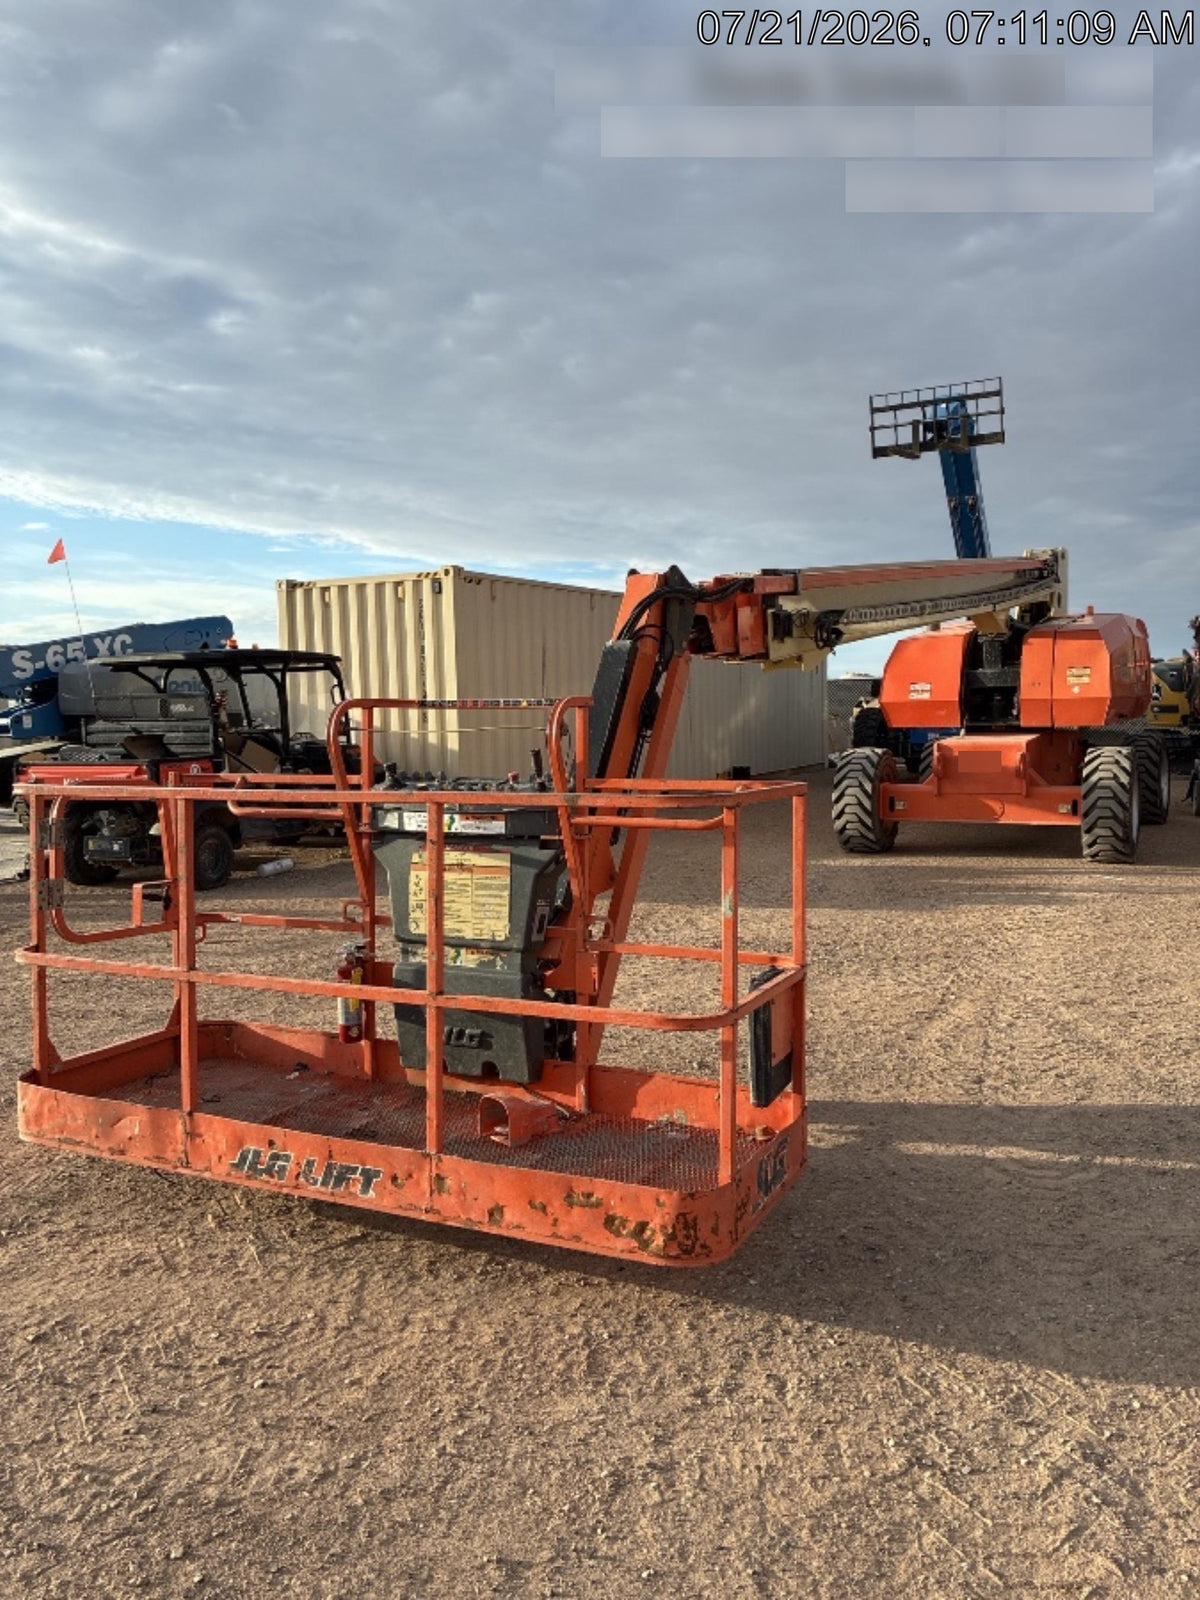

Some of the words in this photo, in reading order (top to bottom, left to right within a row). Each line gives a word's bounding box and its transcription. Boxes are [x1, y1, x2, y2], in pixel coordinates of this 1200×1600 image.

[12, 641, 87, 679] S-65
[94, 634, 134, 657] XC
[229, 1146, 294, 1182] JLG
[301, 1157, 384, 1198] LIFT
